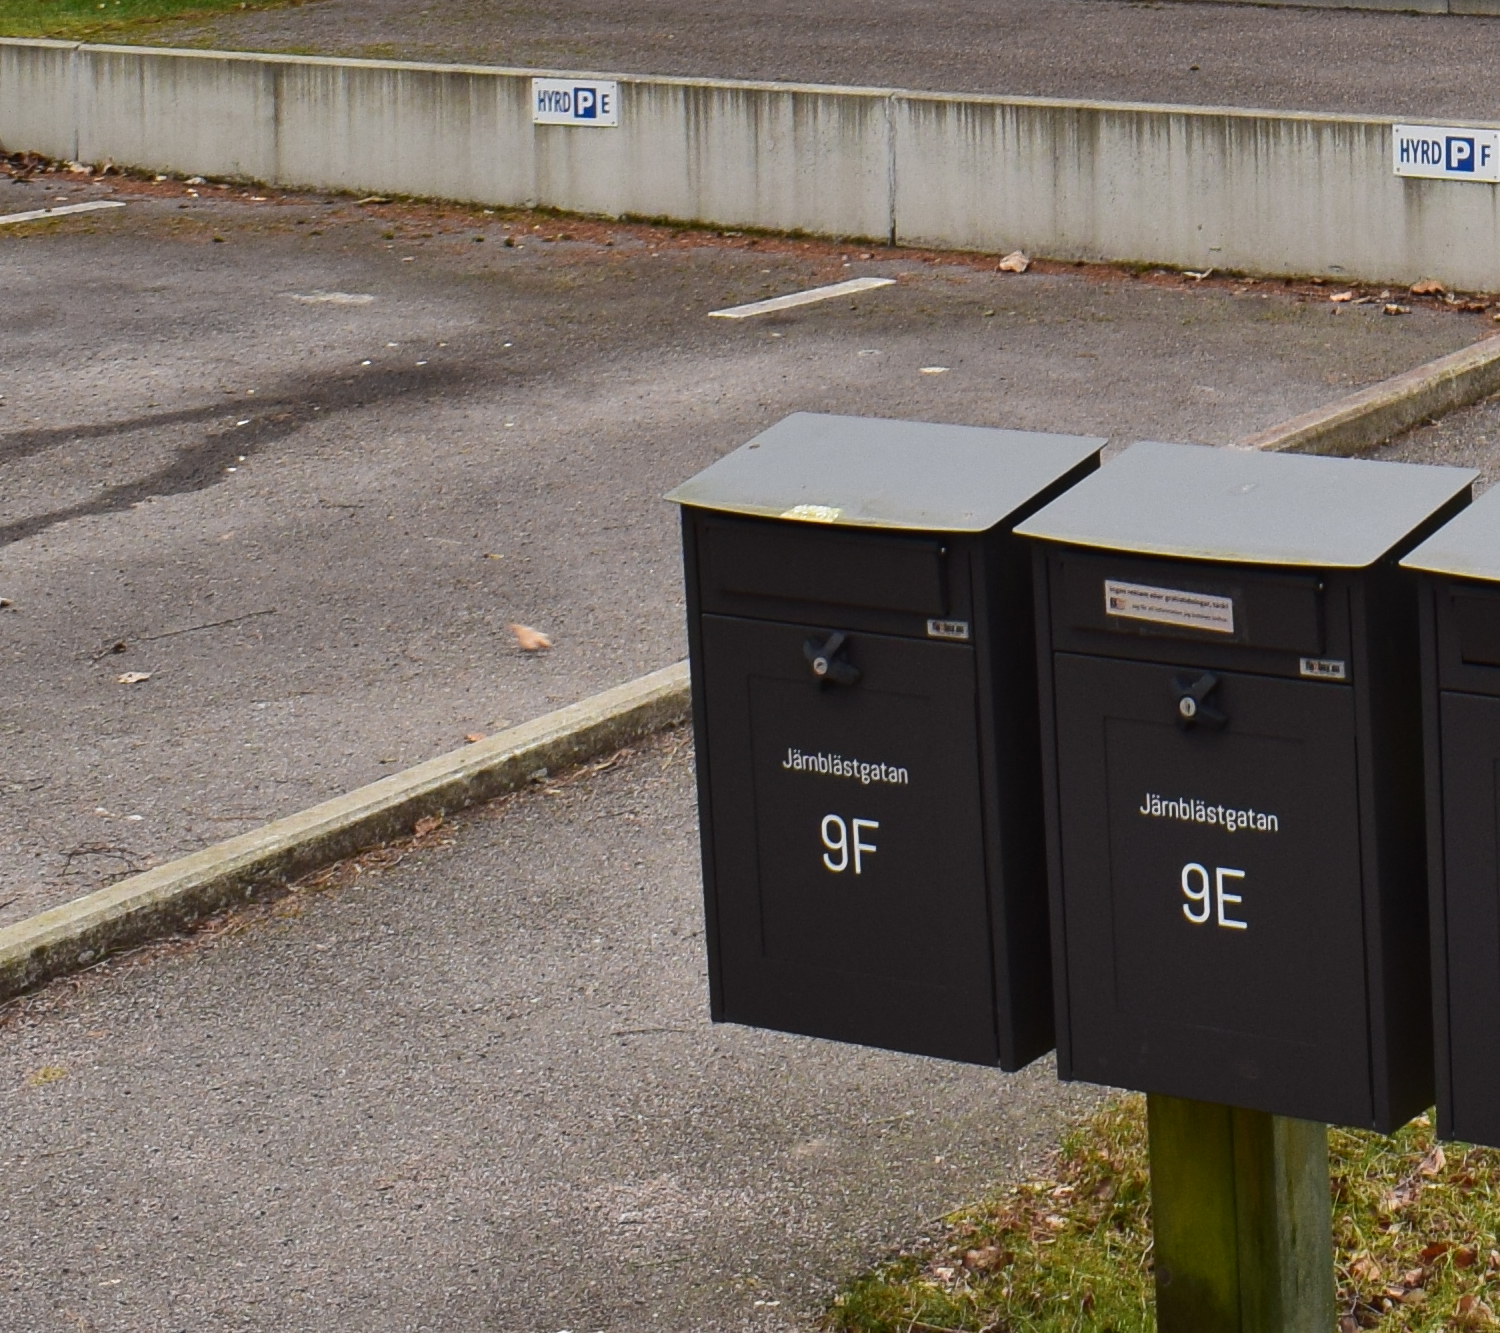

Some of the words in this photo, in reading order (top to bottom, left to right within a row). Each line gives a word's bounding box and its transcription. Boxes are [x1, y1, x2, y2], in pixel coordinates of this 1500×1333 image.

[538, 89, 571, 113] HYRD
[577, 90, 594, 115] P
[602, 93, 610, 114] E
[1400, 137, 1442, 165] HYRD
[1450, 139, 1471, 168] P
[1480, 144, 1491, 167] F
[782, 747, 909, 785] Järnblästgatan
[1139, 792, 1279, 832] Järnblästgatan
[820, 813, 880, 875] 9F
[1181, 862, 1248, 930] 9E
